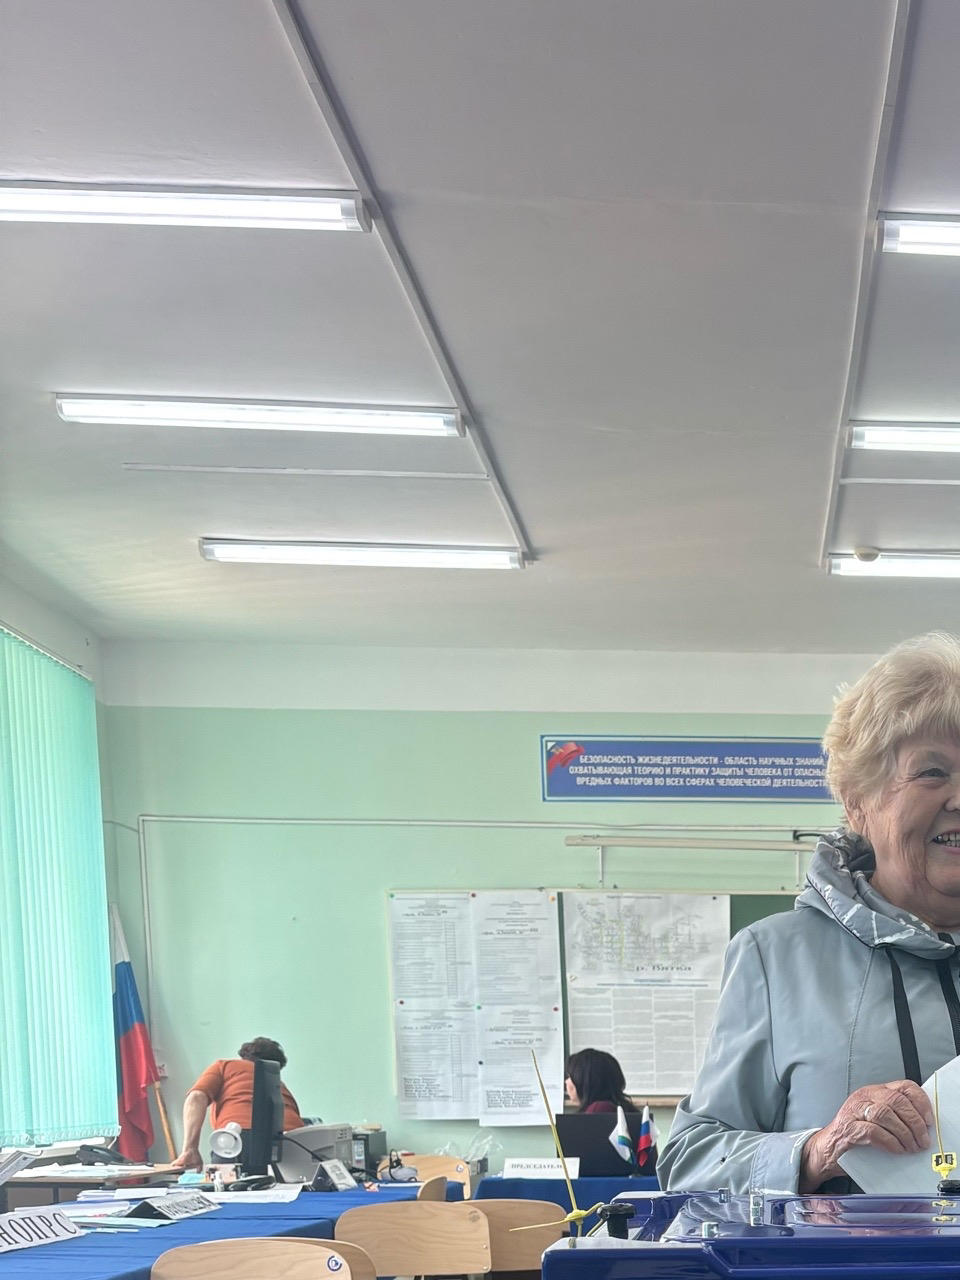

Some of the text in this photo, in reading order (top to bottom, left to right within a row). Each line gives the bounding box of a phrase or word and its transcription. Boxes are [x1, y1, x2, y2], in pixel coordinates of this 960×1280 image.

[580, 755, 636, 764] БЕЗОПАСНОСТЬ
[637, 755, 719, 765] ЖИЗНЕДЕЯТЕЛЬНОСТИ
[724, 756, 758, 765] ОБЛАСТЬ
[759, 757, 794, 765] НАУЧНЫХ
[569, 766, 827, 777] ОХВАТЫВАЮЩАЯ ТЕОРИЮ И ПРАКТИКУ ЗАЩИТЫ ЧЕЛОВЕКА ОТ ОПАСНЫ
[576, 777, 612, 786] ВРЕДНЫХ
[613, 777, 653, 786] ФАКТОРОВ
[654, 778, 665, 786] ВО
[666, 778, 684, 786] ВСЕХ
[686, 778, 715, 787] СФЕРАХ
[717, 776, 771, 787] ЧЕЛОВЕЧЕСКОЙ
[0, 1212, 77, 1247] НОПРС
